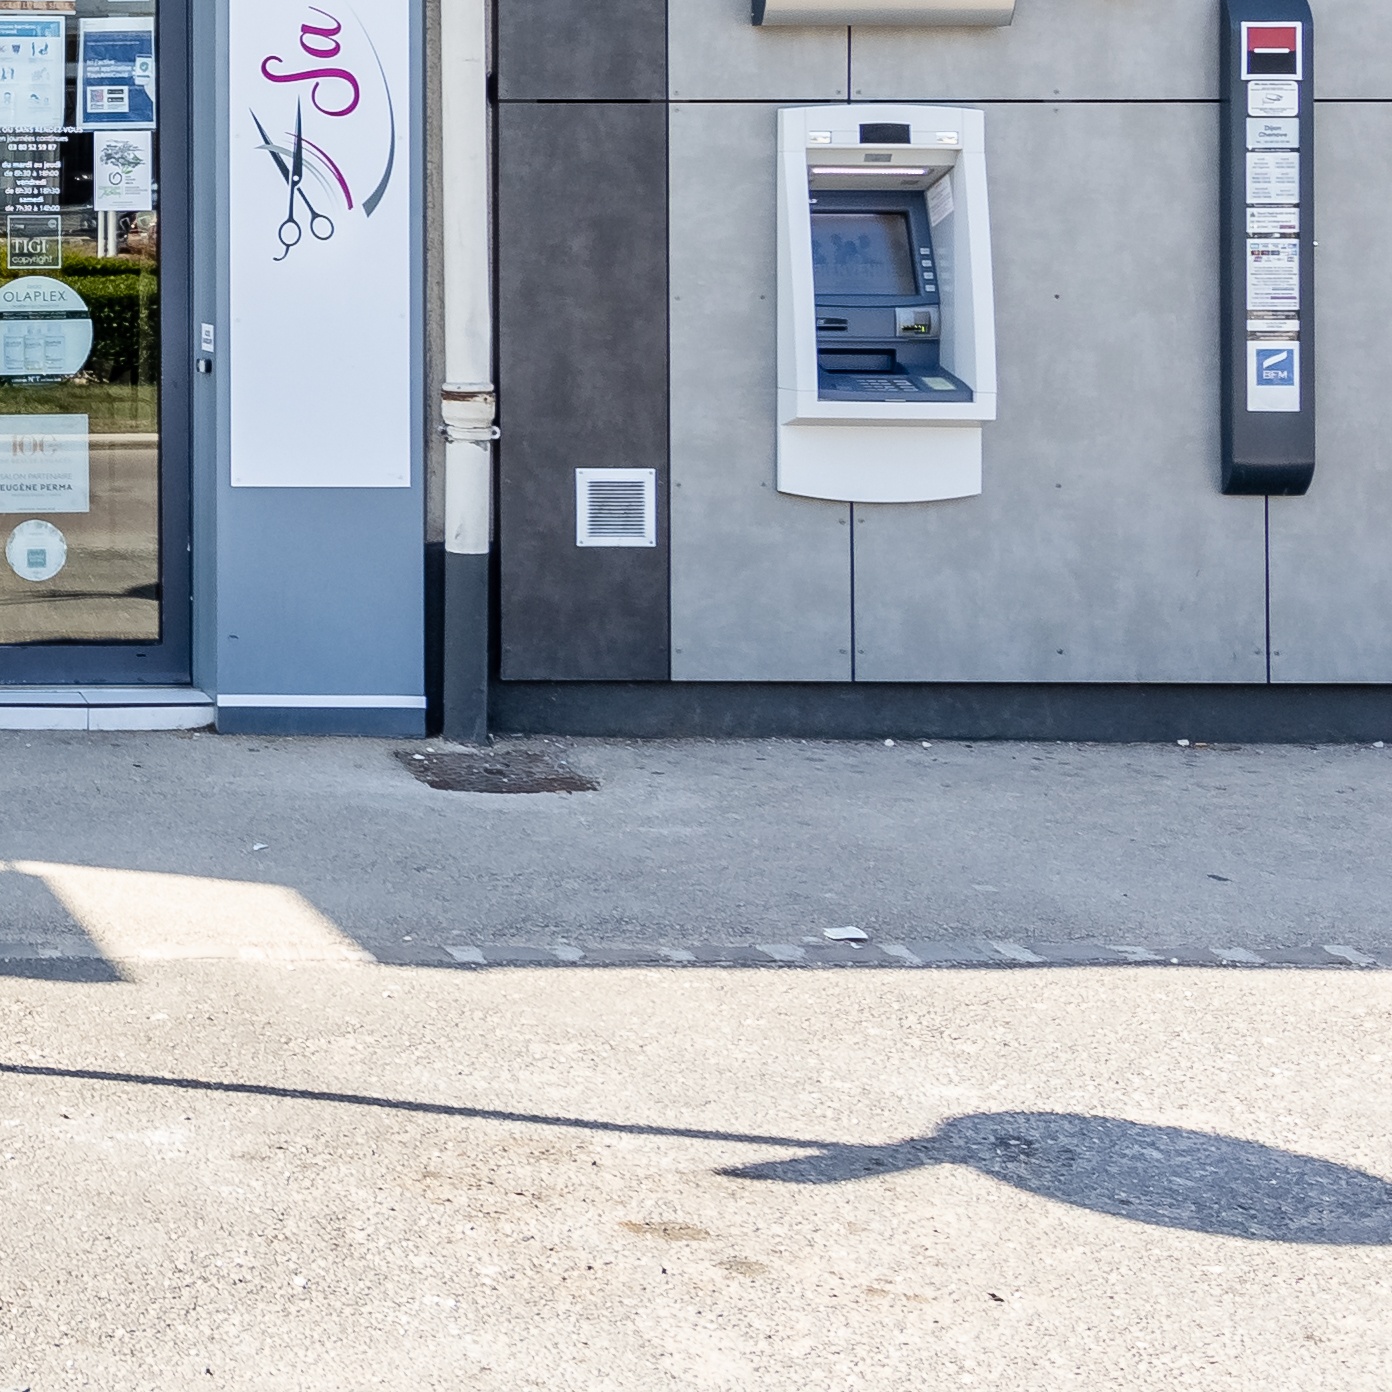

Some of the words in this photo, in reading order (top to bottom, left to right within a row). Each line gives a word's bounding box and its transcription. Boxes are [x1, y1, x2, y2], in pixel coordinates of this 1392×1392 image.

[11, 239, 47, 254] TIGI
[11, 255, 52, 264] copyright
[3, 291, 66, 302] OLAPLEX
[0, 483, 37, 492] EUGÈNE
[40, 484, 73, 492] PERMA
